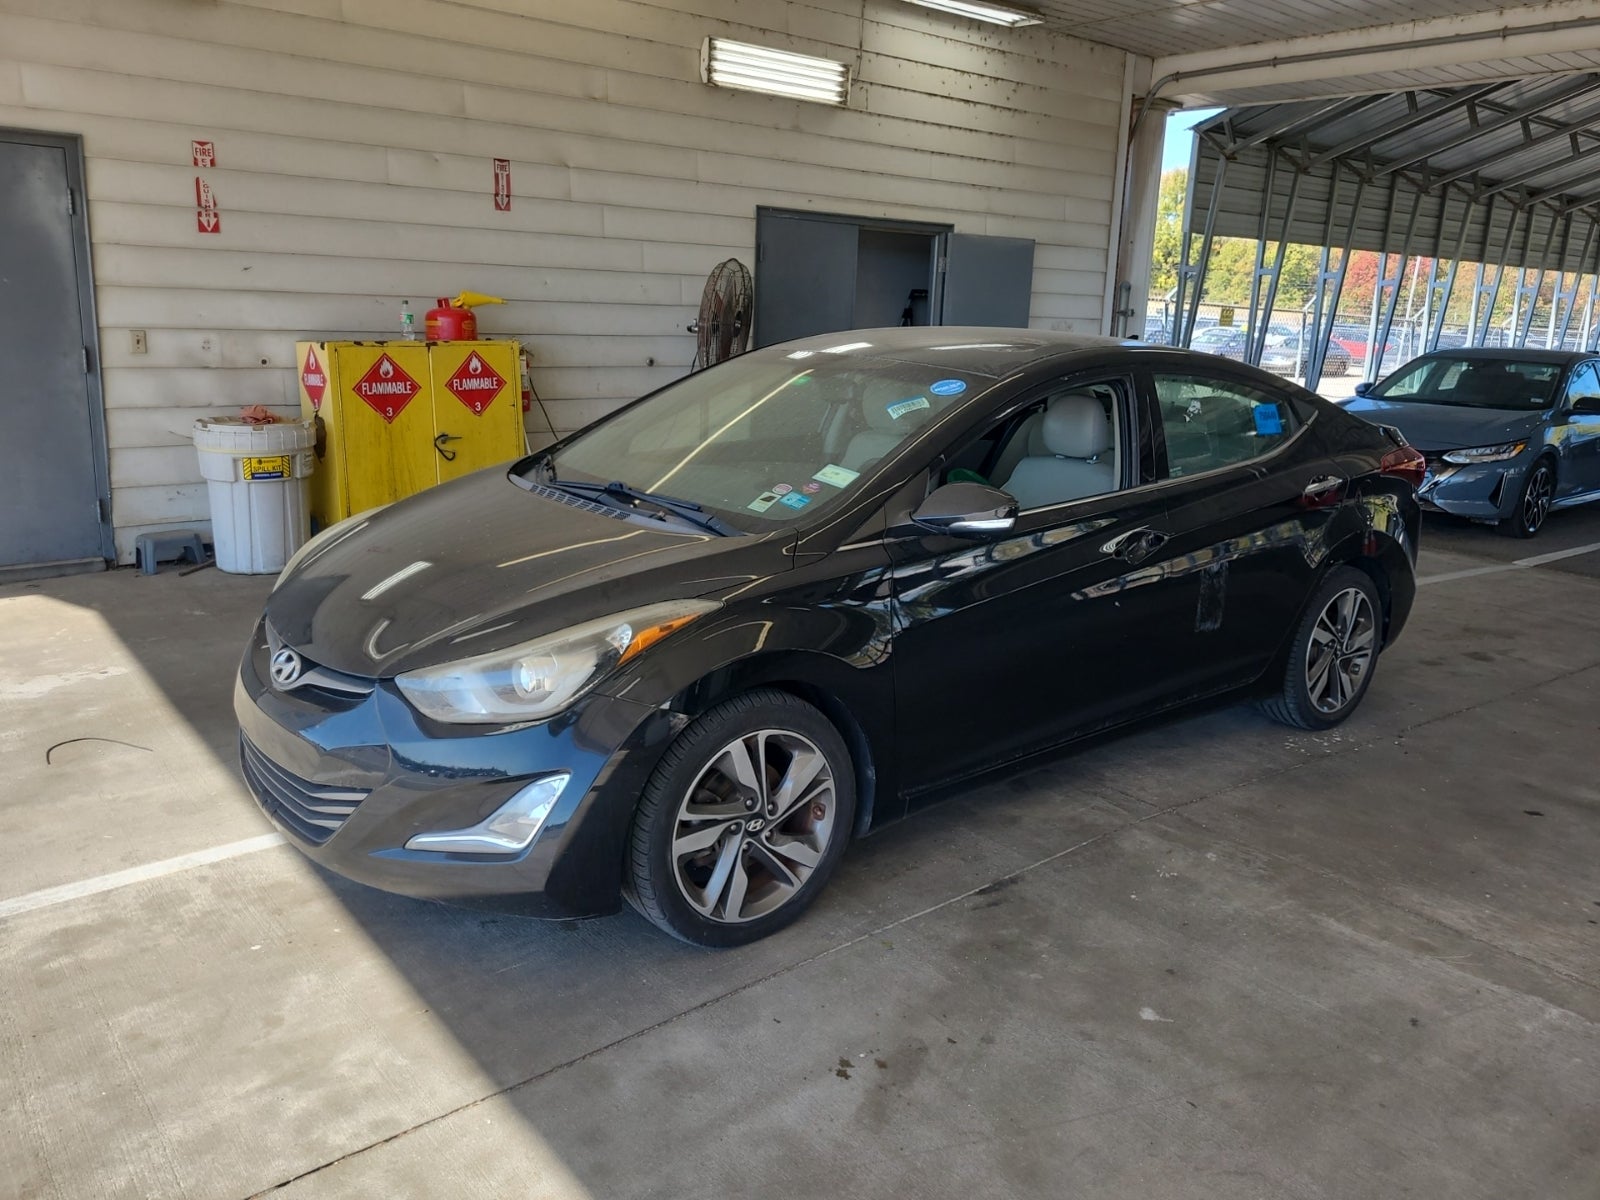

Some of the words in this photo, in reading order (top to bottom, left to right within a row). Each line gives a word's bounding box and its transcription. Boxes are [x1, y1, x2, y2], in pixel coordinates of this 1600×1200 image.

[195, 148, 211, 157] FIRE
[361, 381, 412, 395] FLAMMABLE
[453, 377, 498, 391] FLAMMABLE
[474, 401, 481, 411] 3
[386, 407, 393, 417] 3
